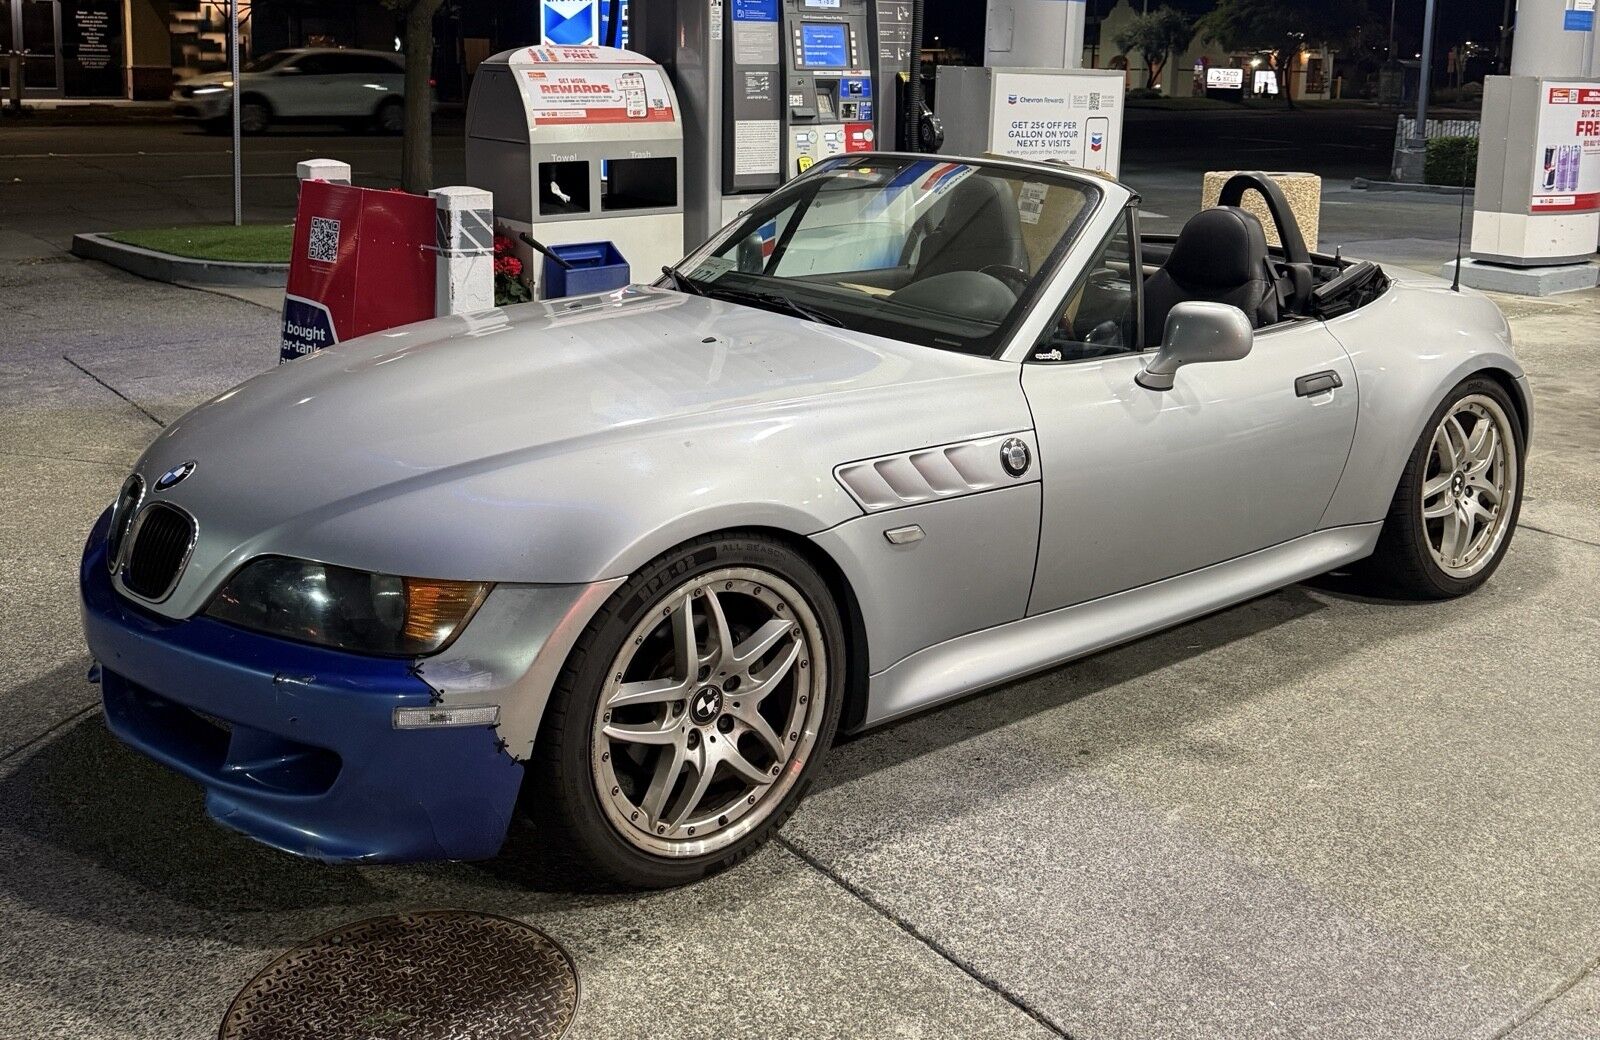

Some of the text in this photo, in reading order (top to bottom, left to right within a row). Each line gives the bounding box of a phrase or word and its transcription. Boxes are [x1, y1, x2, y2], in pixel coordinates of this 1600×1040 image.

[1020, 96, 1043, 104] Chevron
[1591, 109, 1596, 118] 2
[1011, 121, 1029, 129] GET
[1030, 121, 1045, 129] 25¢
[1046, 121, 1062, 129] OFF
[1008, 130, 1078, 138] GALLON ON YOUR
[1016, 139, 1039, 147] NEXT
[1041, 139, 1046, 147] 5
[551, 153, 577, 162] Towel
[630, 151, 651, 159] Trash
[287, 320, 326, 341] bought
[722, 543, 743, 552] ALL
[746, 543, 787, 561] SEASON
